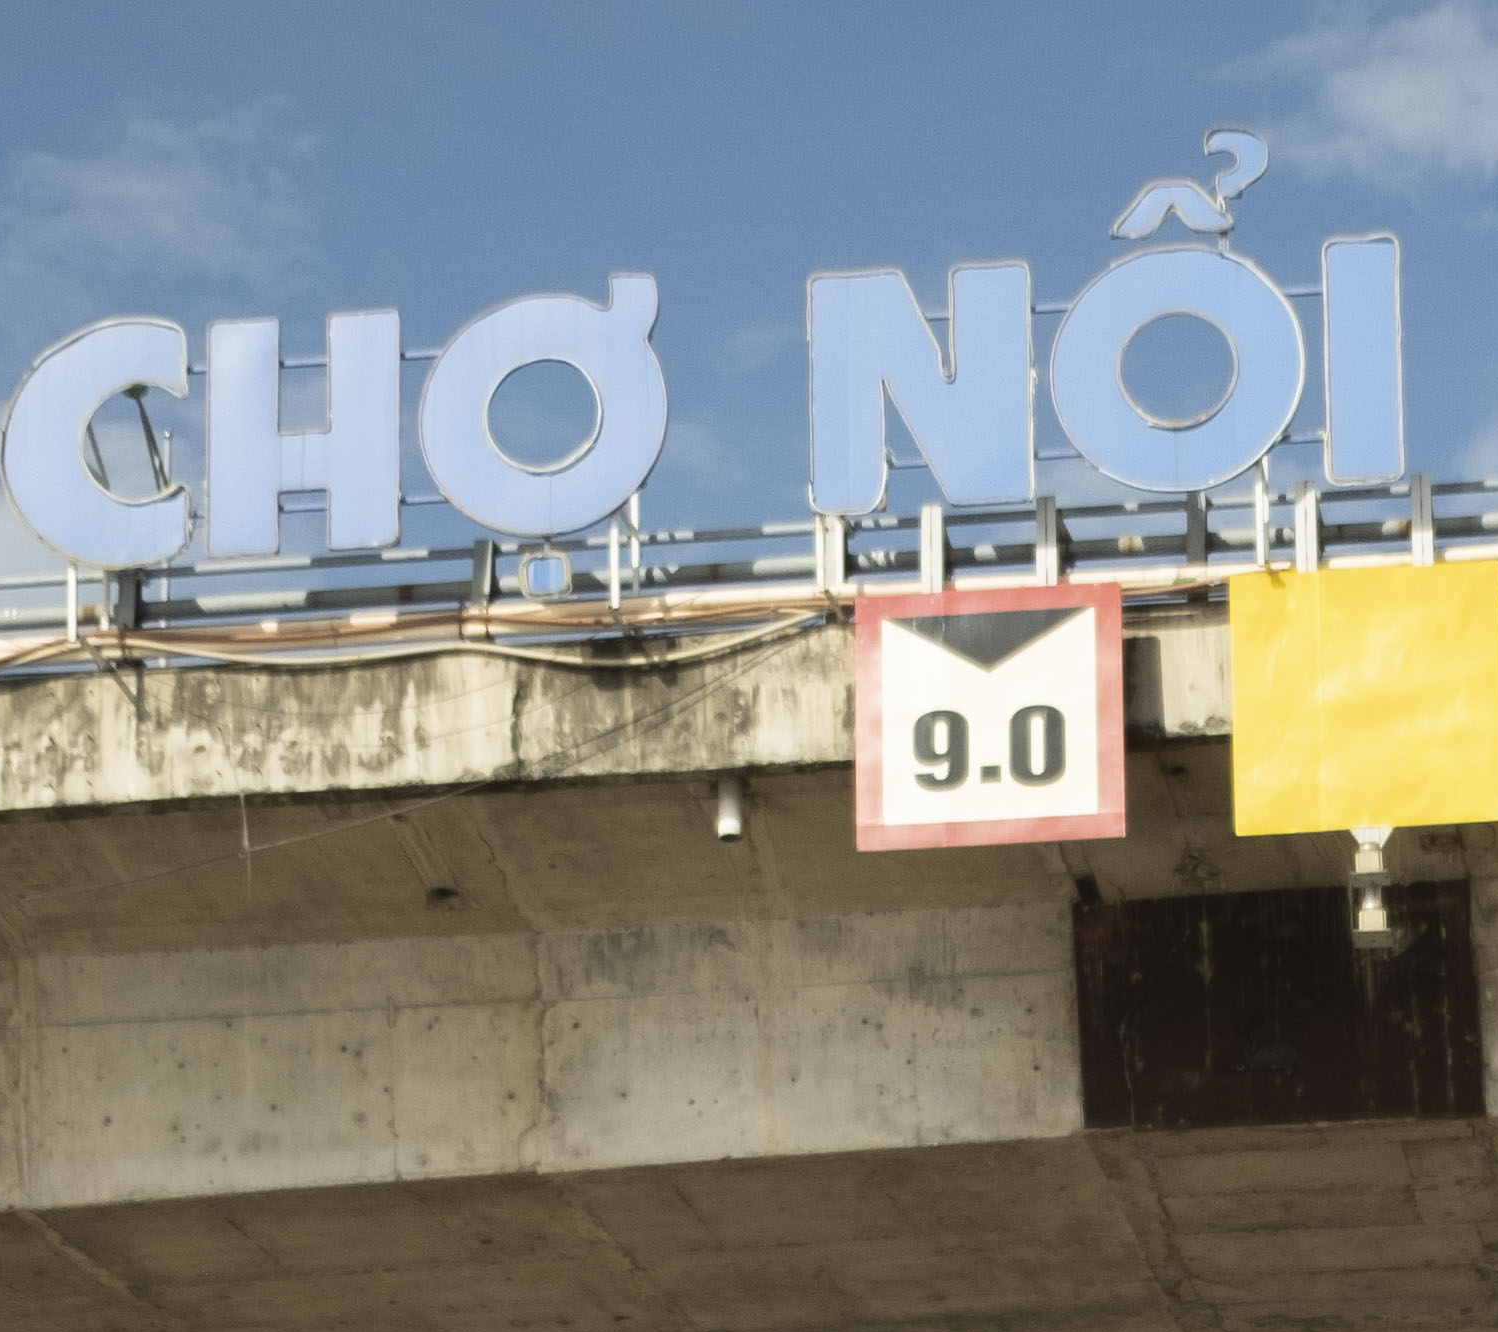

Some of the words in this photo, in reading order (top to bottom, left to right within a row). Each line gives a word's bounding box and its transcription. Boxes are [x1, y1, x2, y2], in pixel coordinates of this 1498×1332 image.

[0, 270, 668, 598] CHỢ
[807, 127, 1406, 515] NỔI
[912, 703, 1066, 791] 9.0
